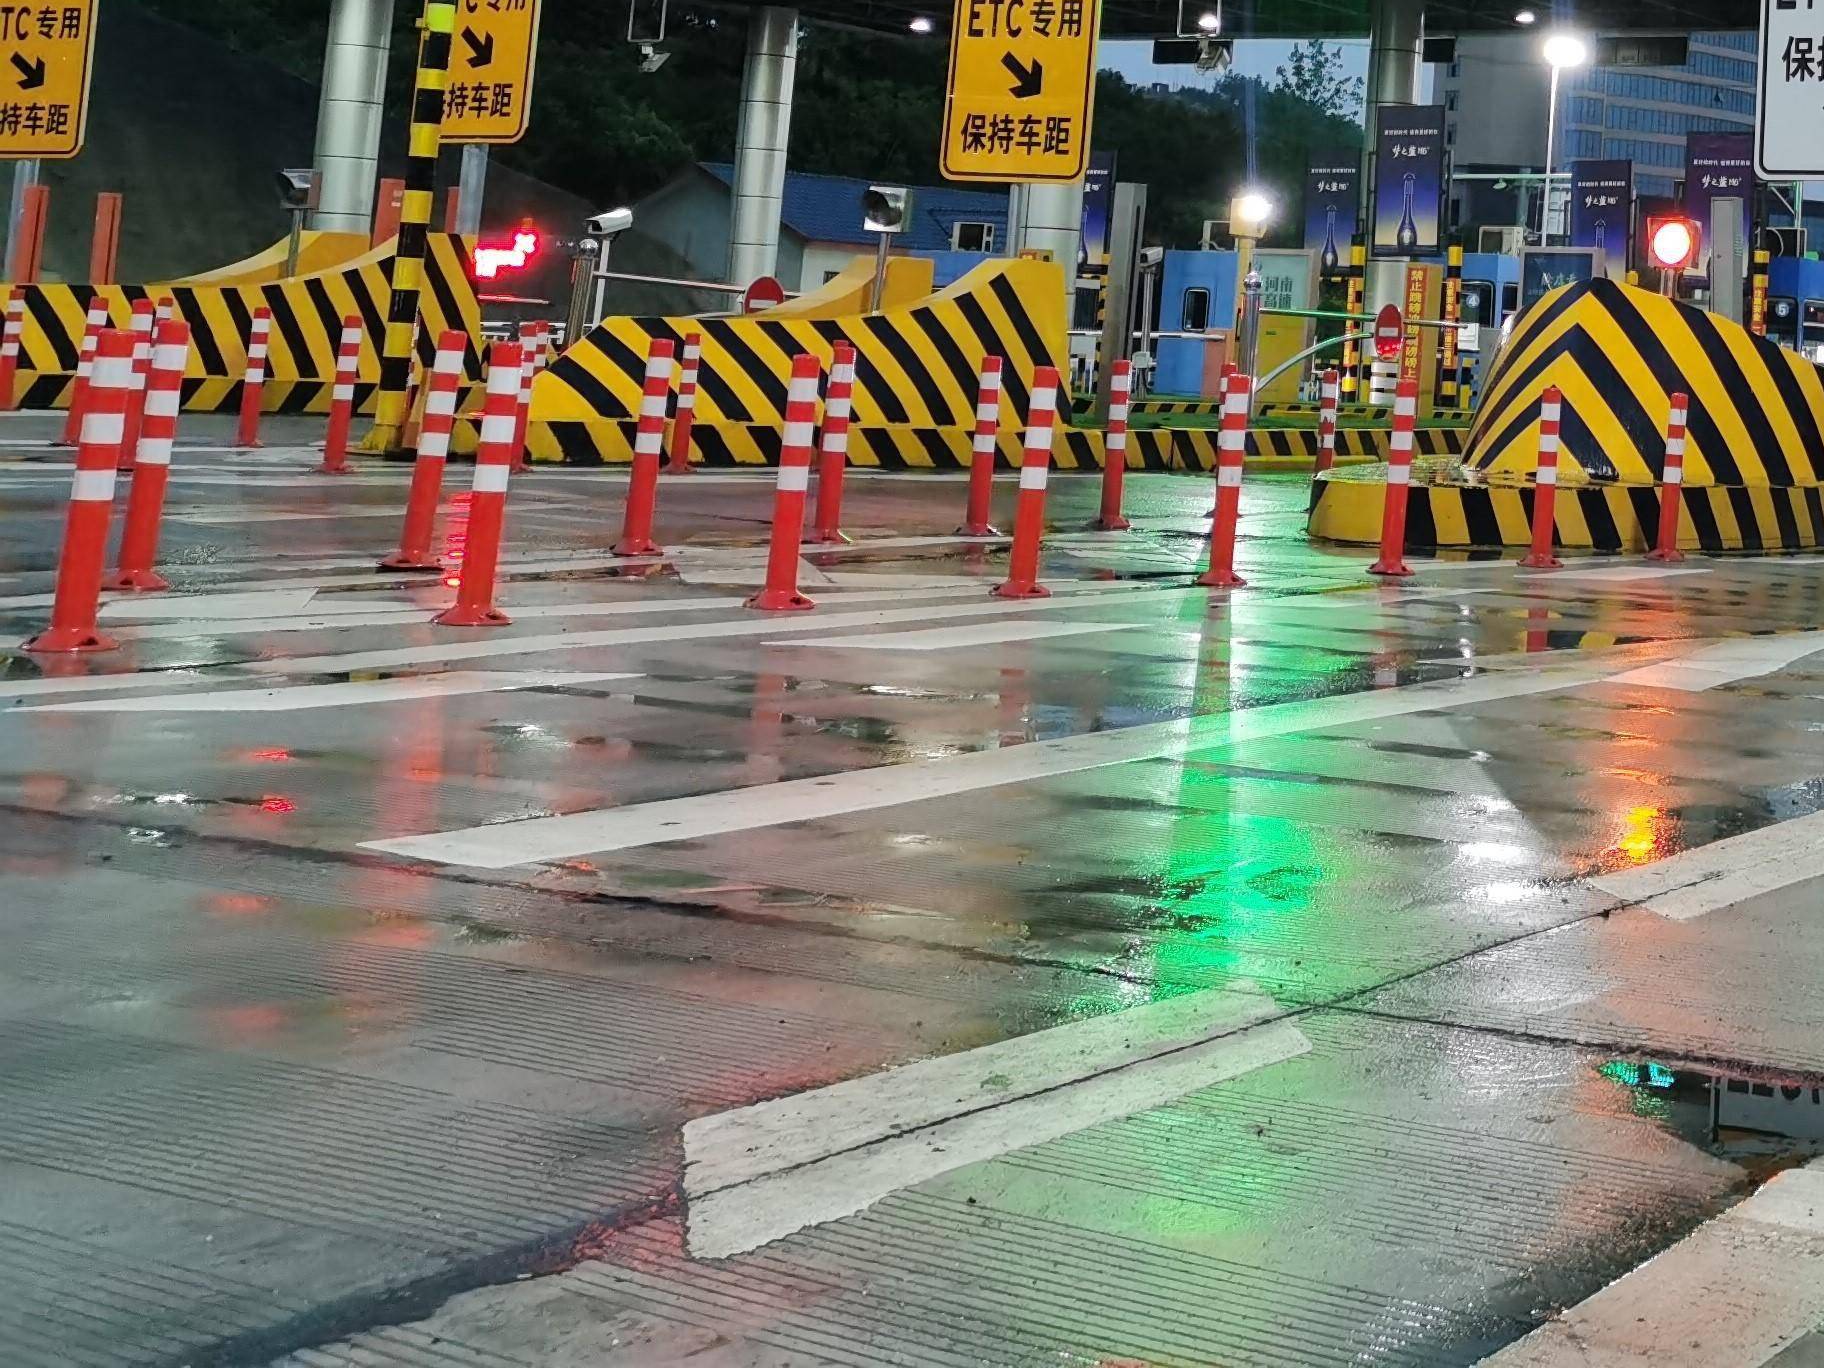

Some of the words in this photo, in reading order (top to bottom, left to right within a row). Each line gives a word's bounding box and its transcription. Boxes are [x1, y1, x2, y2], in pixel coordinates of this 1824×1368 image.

[36, 5, 82, 40] 专用
[442, 82, 513, 120] 持车距
[960, 113, 1073, 156] 保持车距
